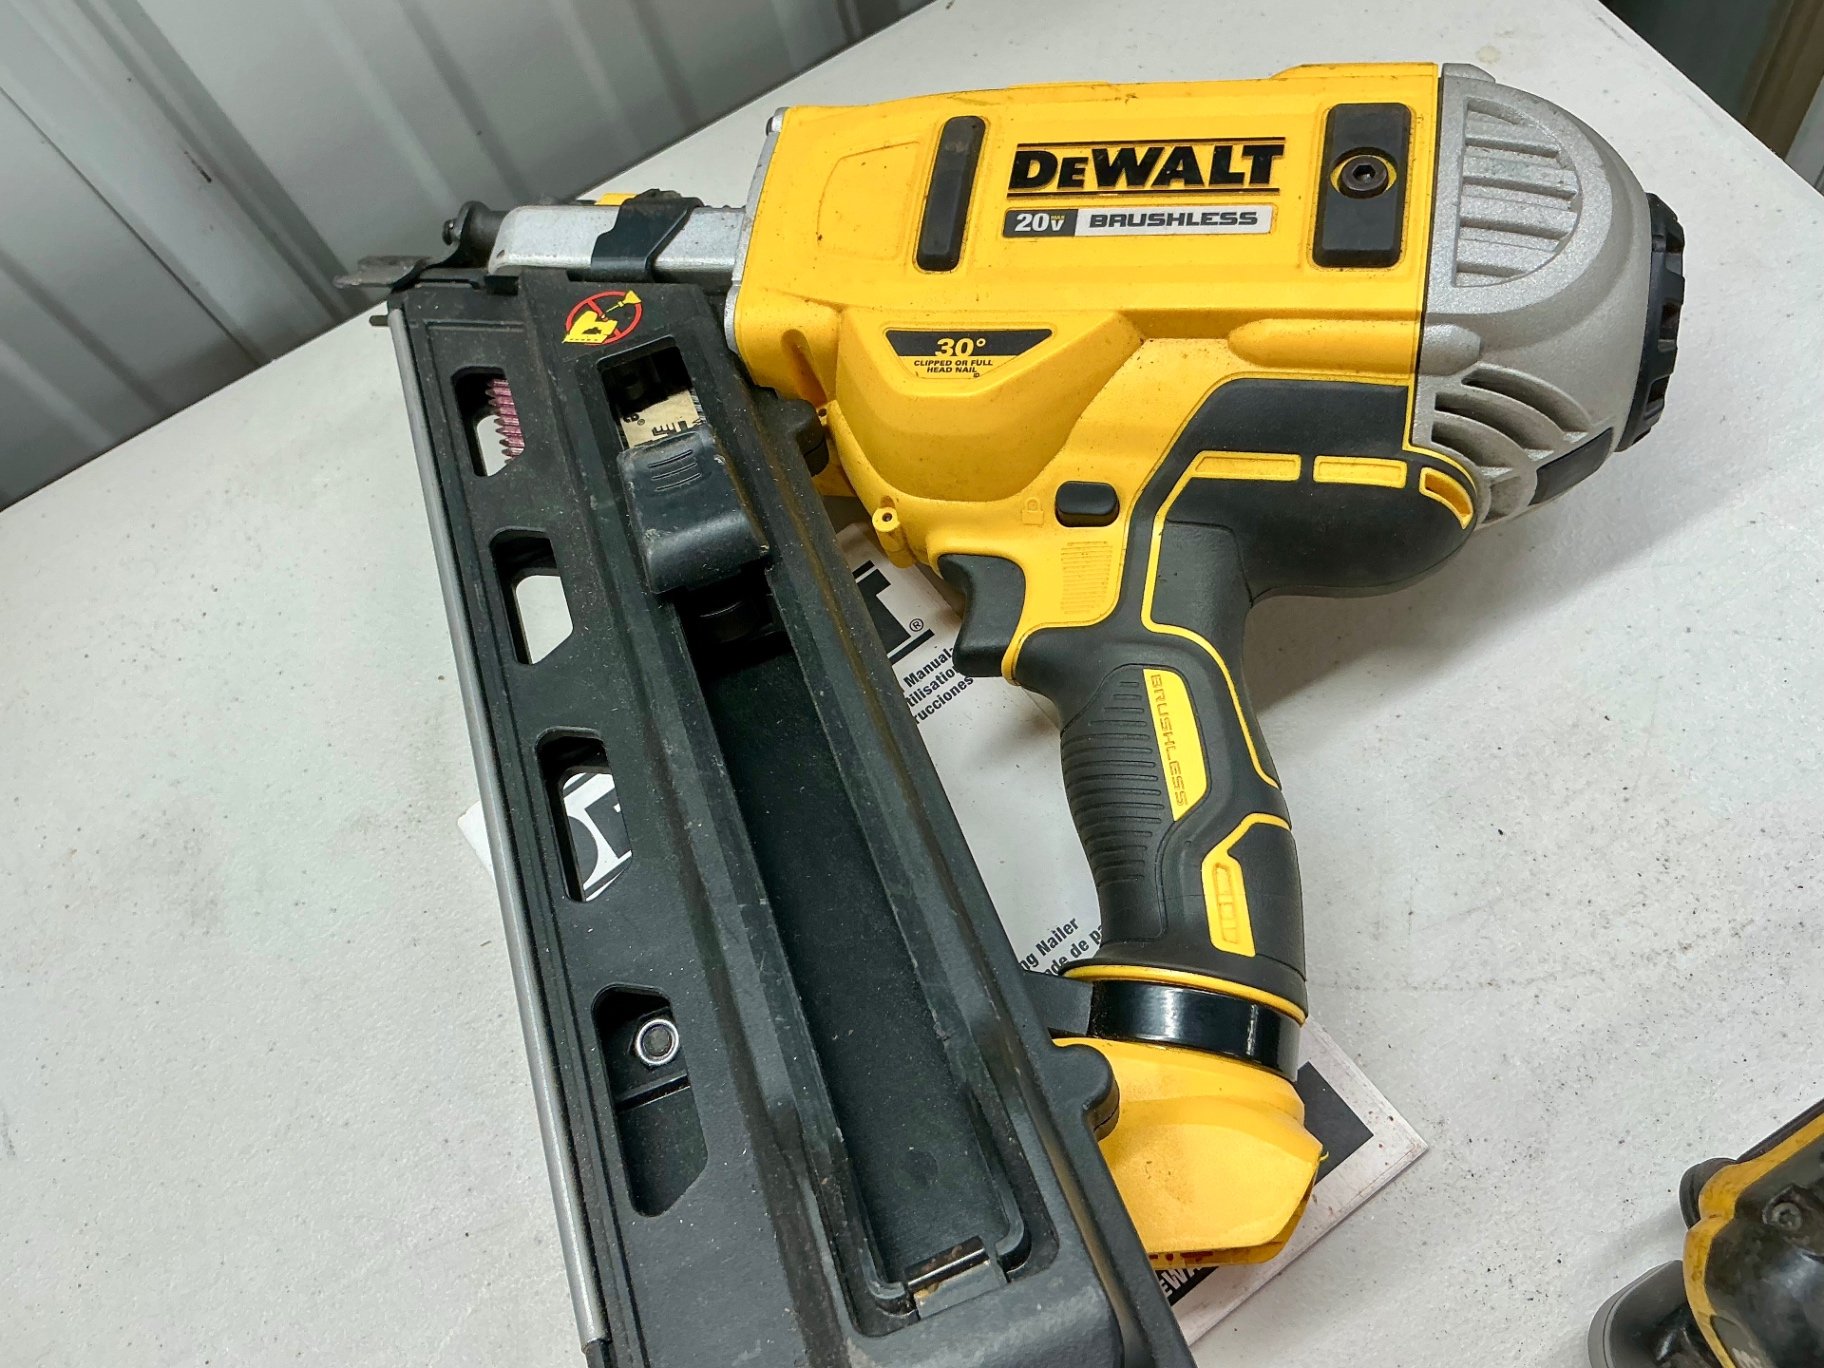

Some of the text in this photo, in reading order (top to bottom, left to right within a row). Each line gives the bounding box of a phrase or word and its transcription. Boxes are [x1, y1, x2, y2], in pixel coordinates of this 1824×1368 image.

[1008, 144, 1285, 190] DEWALT
[1089, 211, 1258, 228] BRUSHLESS
[935, 337, 986, 357] 30°
[913, 358, 993, 367] CLIPPED OR FULL
[903, 648, 953, 688] Manual
[1151, 674, 1188, 806] BRUSHLESS
[1035, 918, 1079, 956] Nailer
[1070, 940, 1090, 958] de
